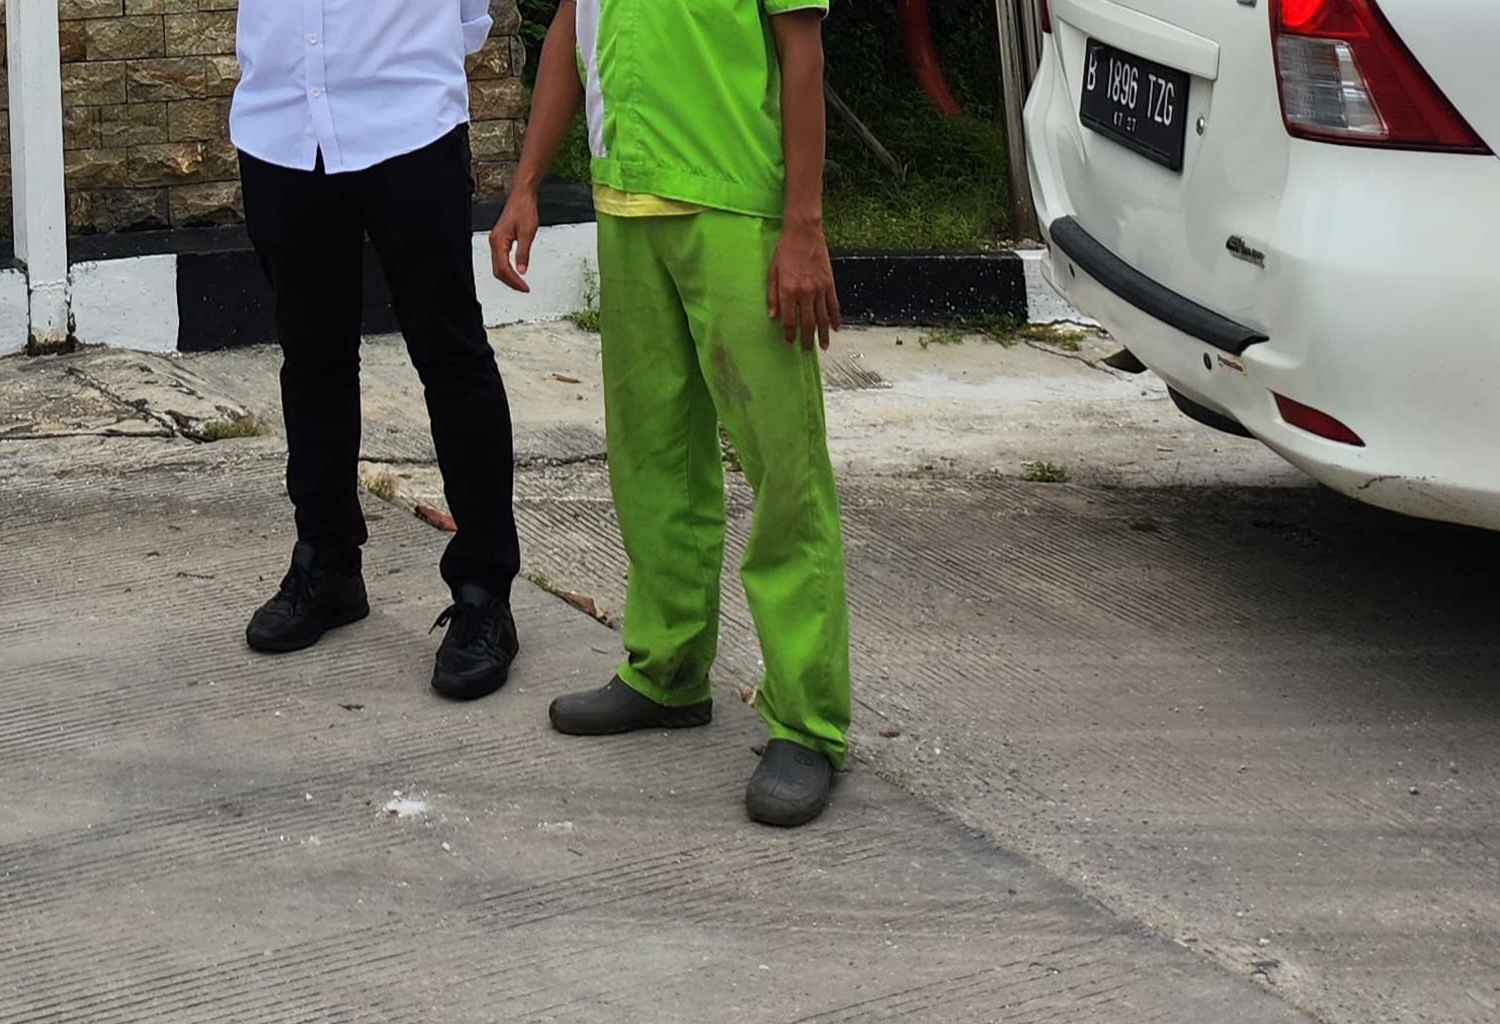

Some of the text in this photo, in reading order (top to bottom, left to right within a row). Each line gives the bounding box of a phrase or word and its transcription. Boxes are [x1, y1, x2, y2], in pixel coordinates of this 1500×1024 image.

[1087, 52, 1175, 126] B 1896 TZG
